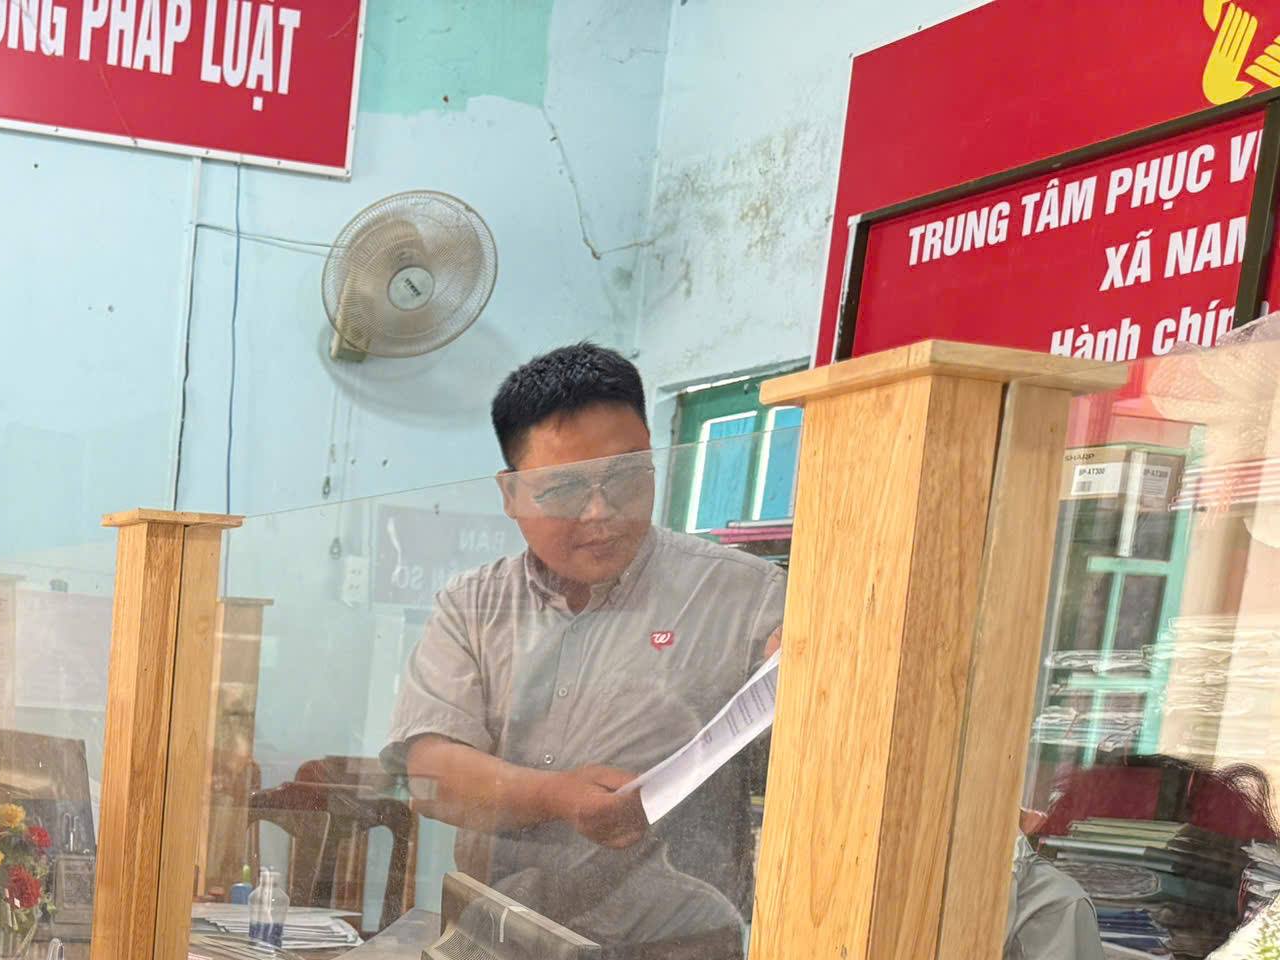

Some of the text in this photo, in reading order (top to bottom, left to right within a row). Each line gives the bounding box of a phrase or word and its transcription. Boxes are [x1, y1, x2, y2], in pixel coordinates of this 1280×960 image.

[909, 129, 1264, 266] TRUNG TÂM PHỤC V
[1099, 228, 1153, 292] XÃ
